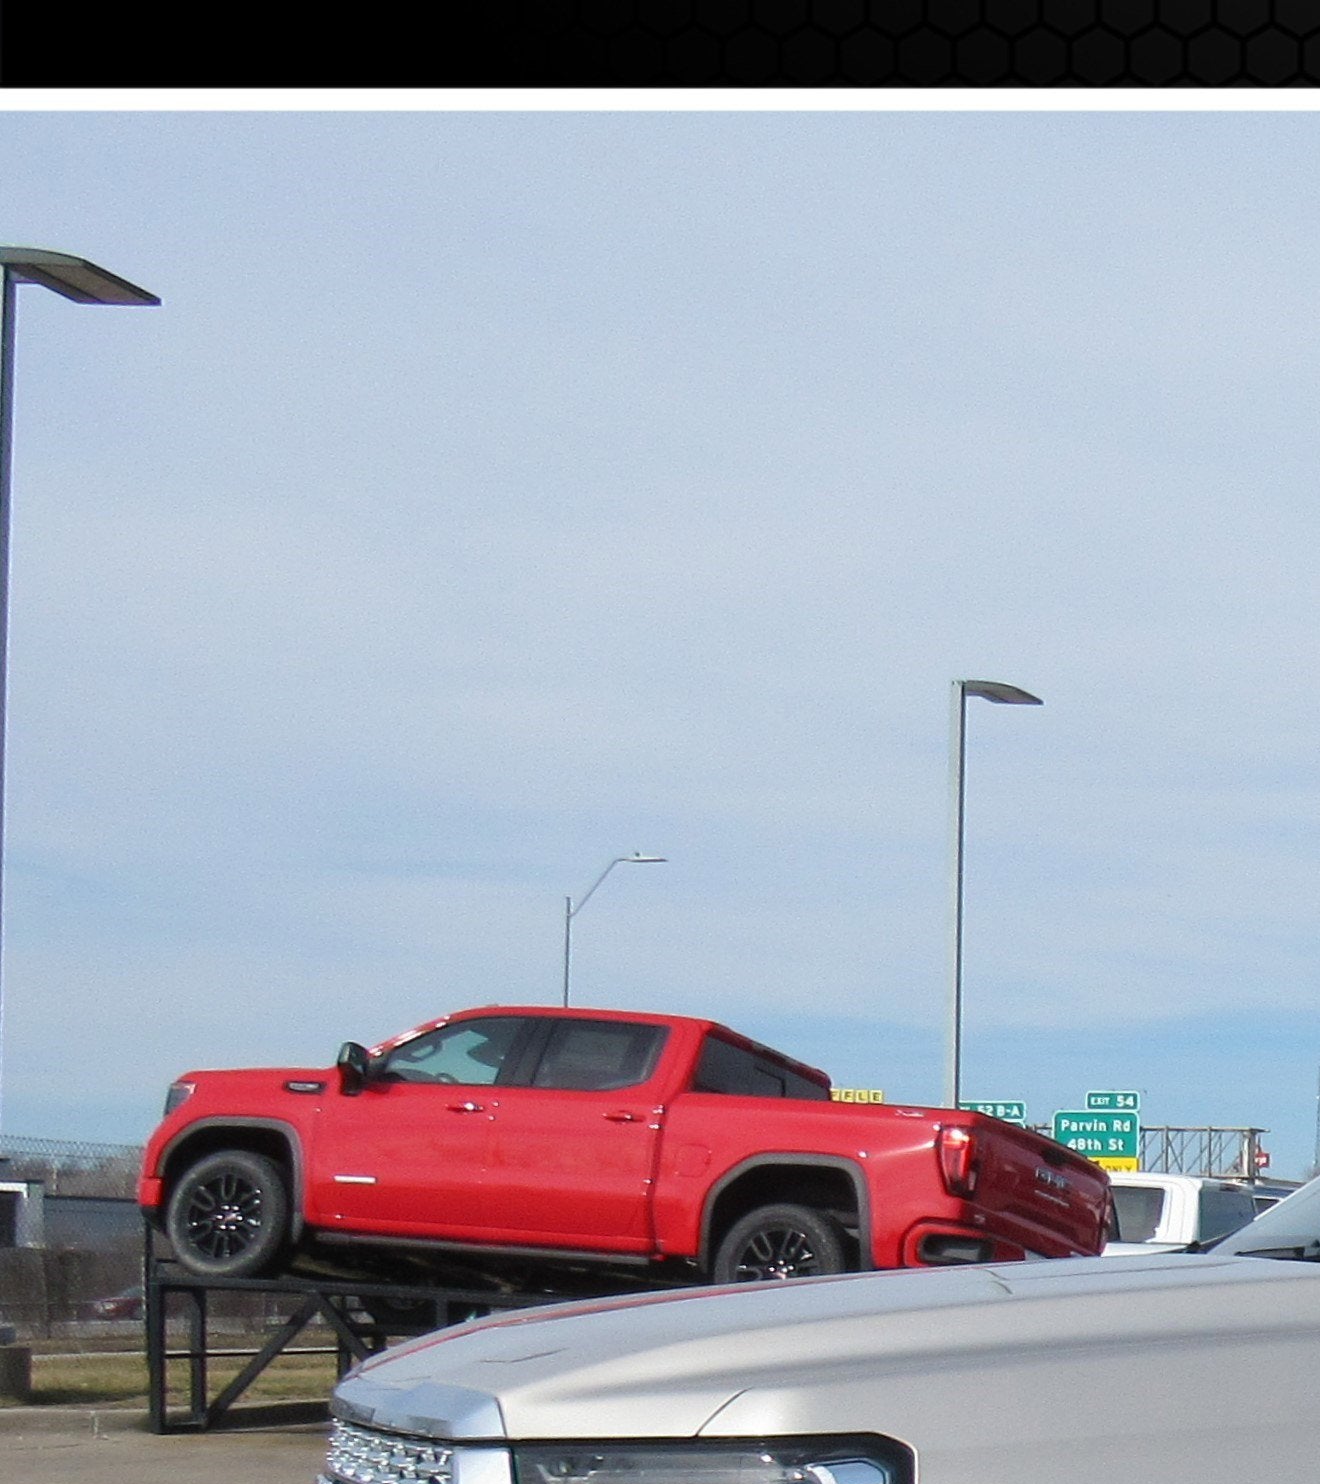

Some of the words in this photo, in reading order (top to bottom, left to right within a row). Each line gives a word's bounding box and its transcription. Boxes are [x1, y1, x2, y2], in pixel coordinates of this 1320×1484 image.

[1090, 1096, 1110, 1105] EXIT
[1116, 1095, 1134, 1107] 54
[1061, 1119, 1107, 1132] Parvin
[1112, 1119, 1131, 1132] Rd
[1067, 1138, 1102, 1151] 48th
[1108, 1138, 1124, 1151] St
